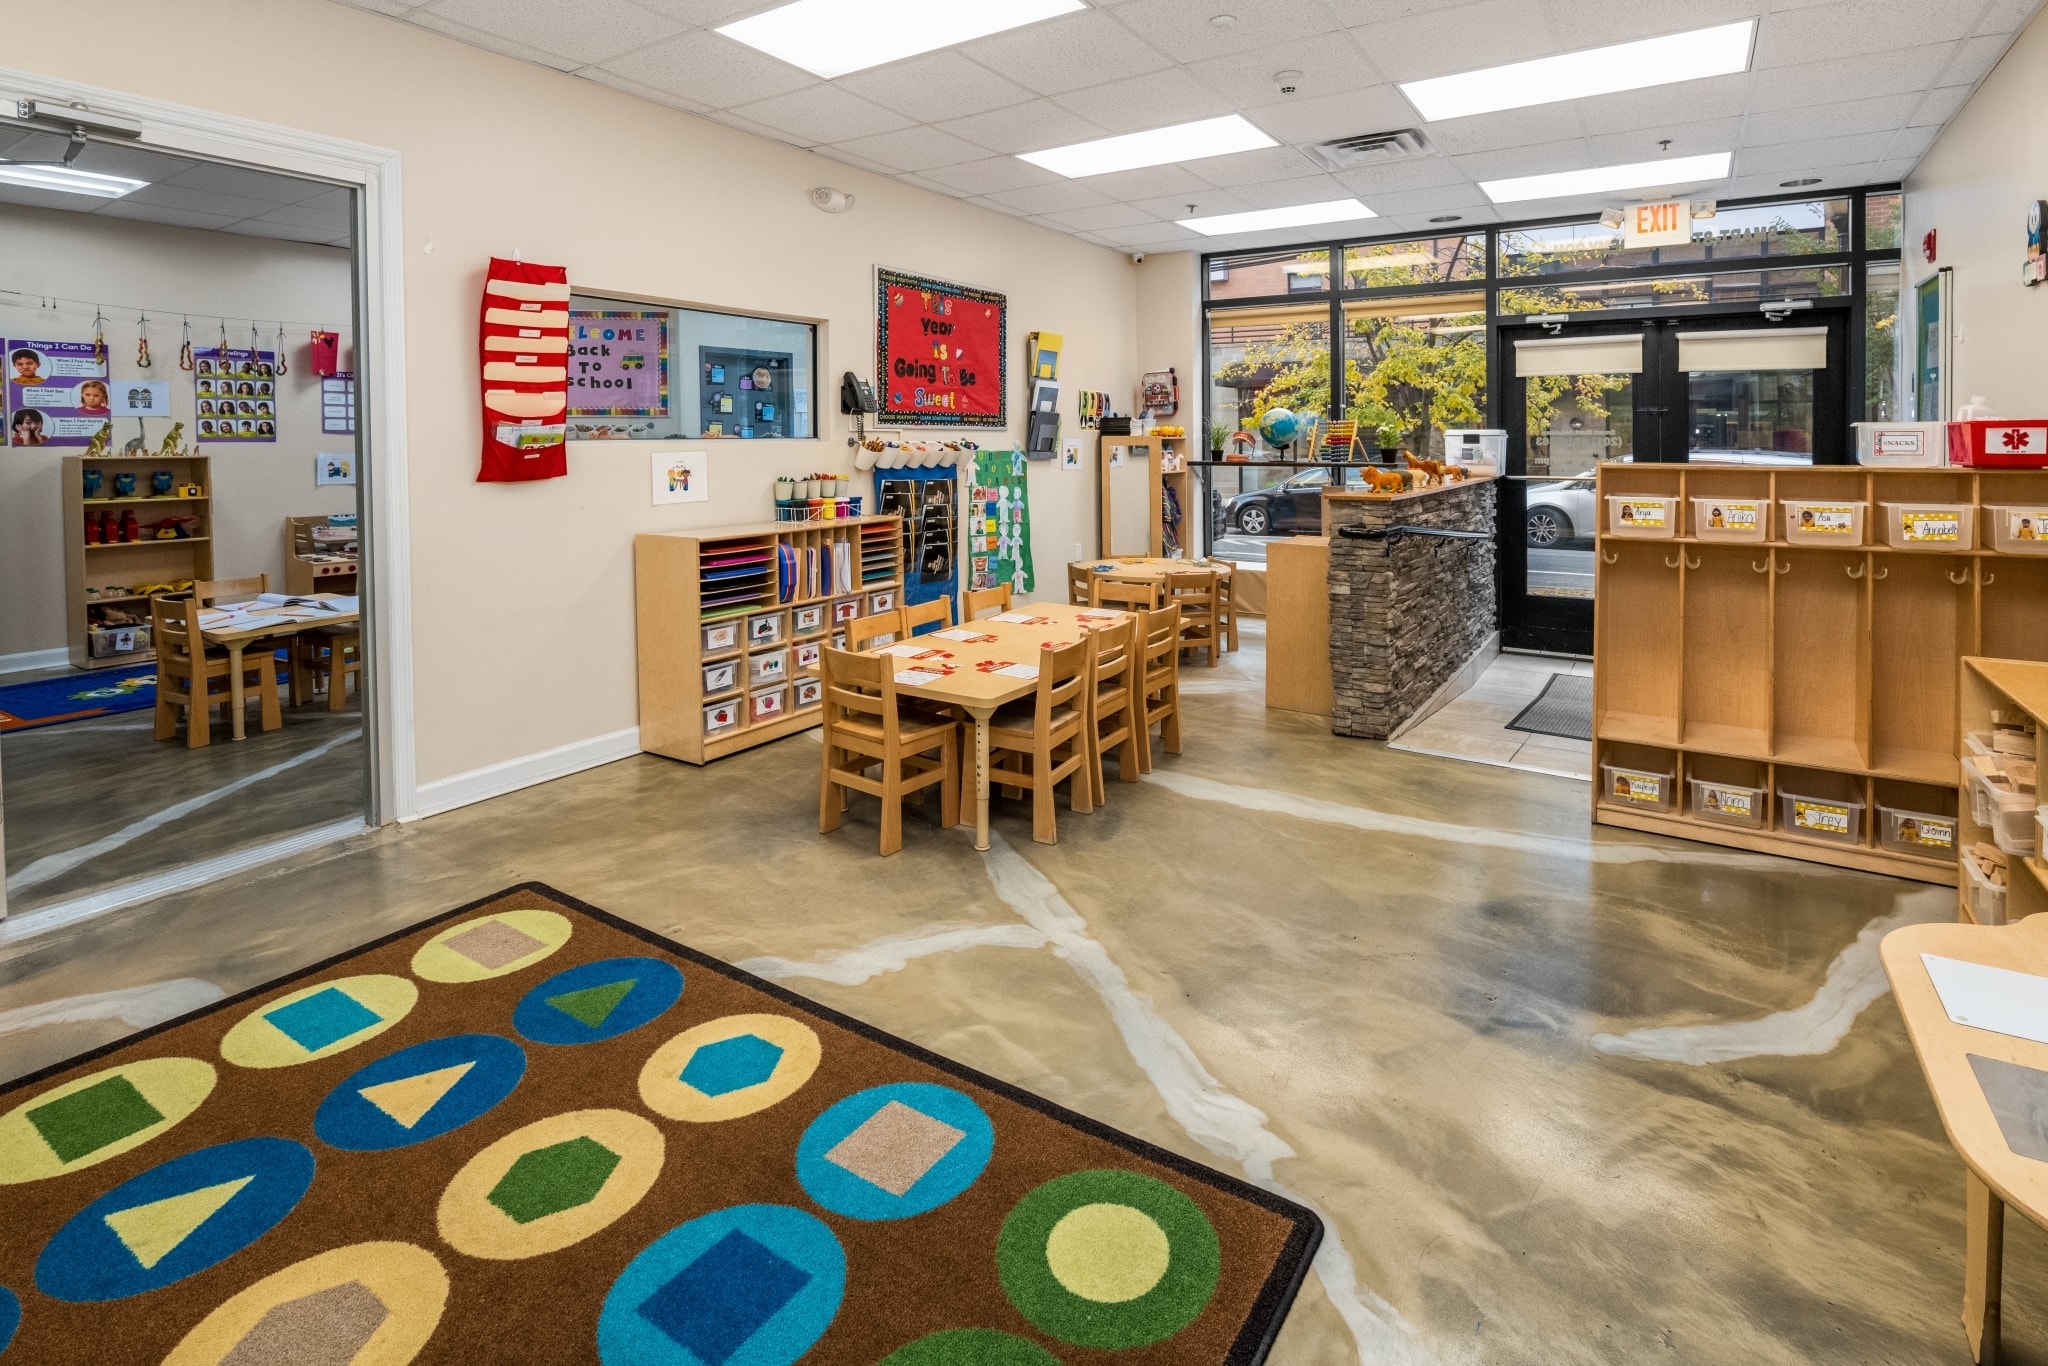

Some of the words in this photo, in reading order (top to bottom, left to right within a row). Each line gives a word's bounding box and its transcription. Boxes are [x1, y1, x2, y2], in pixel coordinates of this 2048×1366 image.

[1637, 203, 1680, 234] EXIT
[569, 325, 646, 342] ELCOME
[921, 317, 955, 336] Year
[27, 341, 53, 350] Things
[62, 343, 78, 351] Can
[568, 344, 610, 357] Back
[894, 357, 936, 384] Going
[960, 368, 976, 386] Be
[915, 387, 956, 410] Sweet
[1634, 507, 1651, 520] Arya
[1727, 509, 1754, 523] Aniko
[1817, 512, 1831, 522] Asa
[1922, 522, 1959, 535] Annabeth
[1816, 812, 1842, 830] Trey
